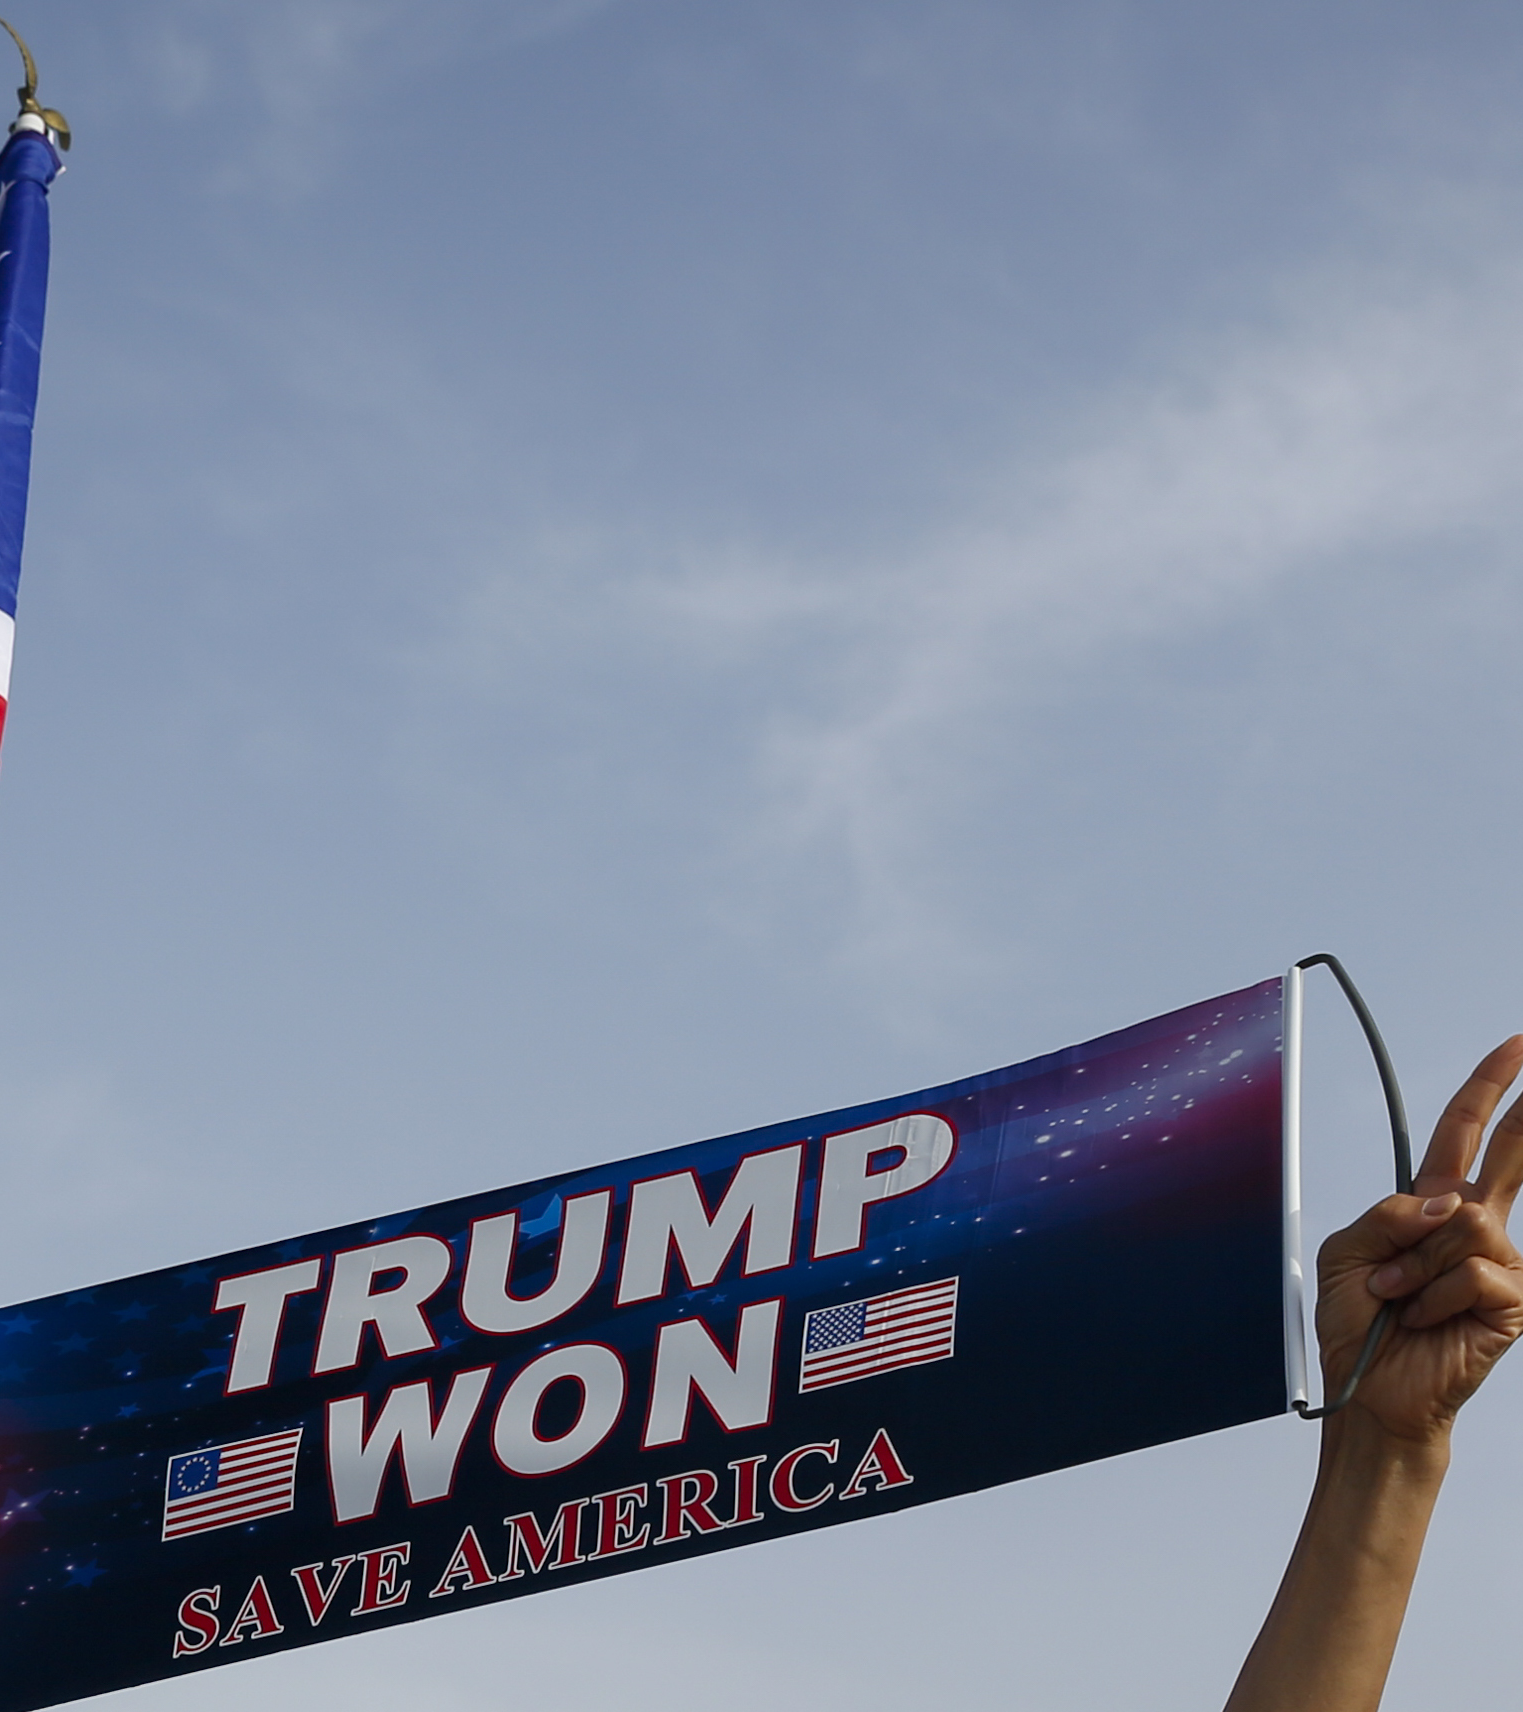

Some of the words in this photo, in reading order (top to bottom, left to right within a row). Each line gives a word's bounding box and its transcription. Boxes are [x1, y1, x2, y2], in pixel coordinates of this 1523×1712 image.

[214, 1112, 960, 1397] TRUMP
[324, 1296, 780, 1527] WON
[171, 1540, 412, 1661] SAVE
[429, 1427, 914, 1600] AMERICA
